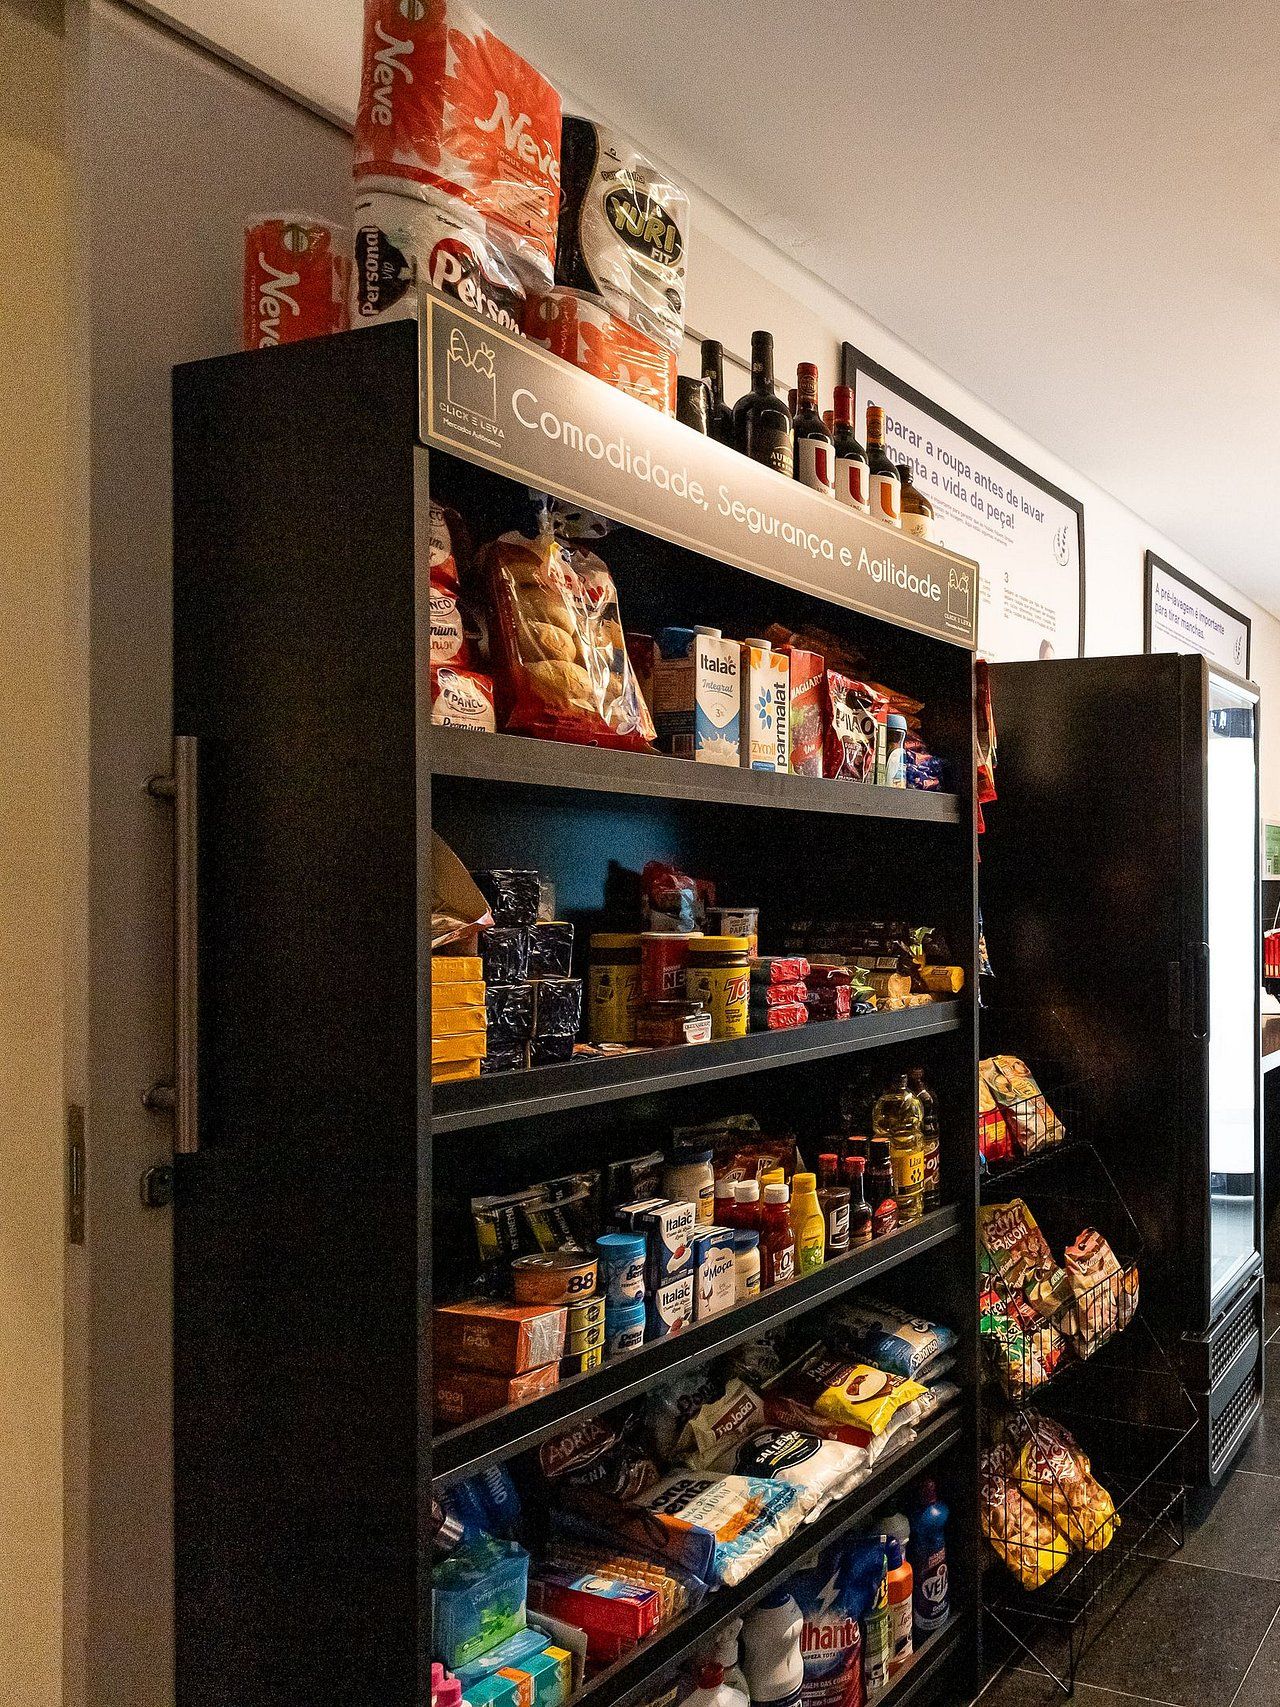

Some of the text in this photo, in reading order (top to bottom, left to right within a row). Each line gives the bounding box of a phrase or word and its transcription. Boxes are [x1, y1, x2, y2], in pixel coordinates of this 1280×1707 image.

[371, 20, 415, 127] Neve
[473, 90, 561, 188] Neve
[610, 196, 677, 252] YURI
[362, 224, 380, 317] Personal
[439, 402, 470, 422] CLICK
[480, 420, 506, 440] LEVA
[511, 388, 941, 602] Comodidade, Segurança e Agilidade
[885, 443, 928, 481] menta
[931, 471, 939, 487] a
[942, 476, 967, 503] vida
[970, 491, 985, 513] da
[986, 505, 1015, 530] peça!
[926, 441, 934, 458] a
[937, 446, 972, 480] roupa
[974, 470, 1004, 498] antes
[1006, 488, 1019, 509] de
[1021, 496, 1045, 524] lavar
[1155, 582, 1160, 594] A
[1161, 588, 1195, 615] pré-lavagem
[1200, 610, 1225, 636] importante
[1155, 602, 1168, 618] para
[1168, 609, 1180, 624] tirar
[700, 653, 737, 676] Italac
[702, 678, 734, 693] Integral
[773, 682, 787, 768] parmalat
[666, 1214, 693, 1233] Italac
[568, 1271, 594, 1295] 88
[704, 1259, 734, 1281] Moça
[662, 1286, 691, 1307] Italac
[801, 1619, 860, 1653] lhante
